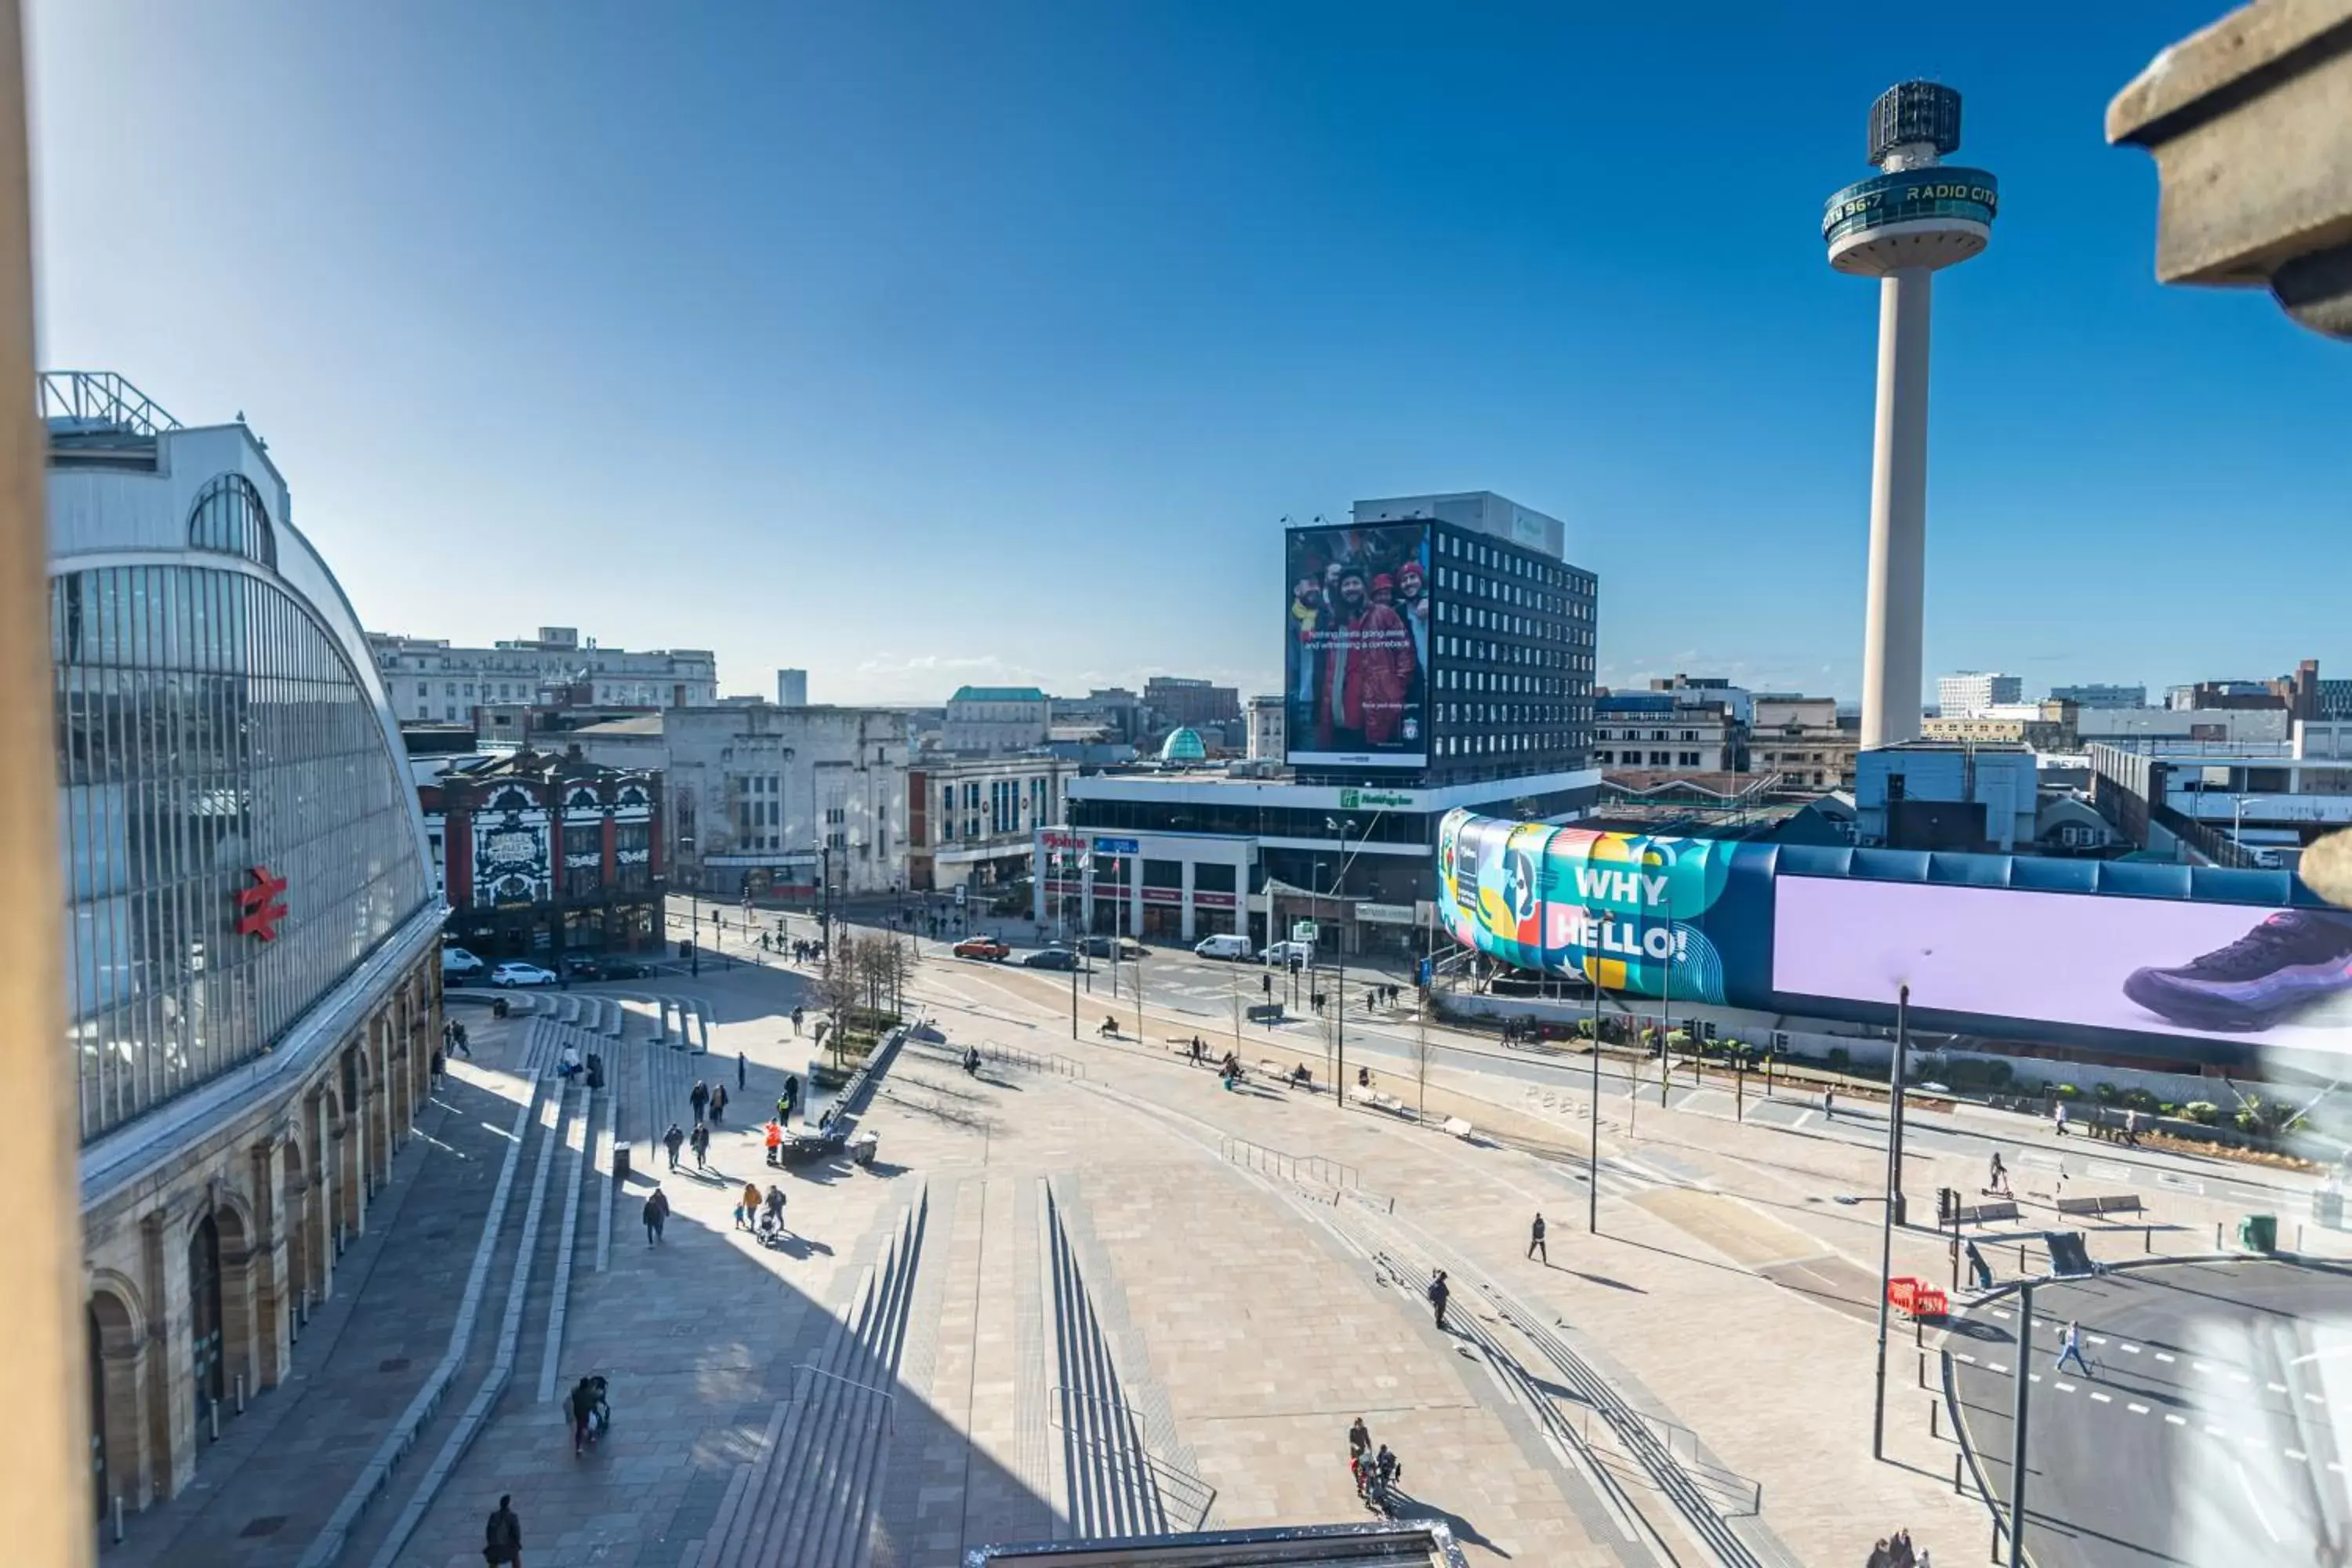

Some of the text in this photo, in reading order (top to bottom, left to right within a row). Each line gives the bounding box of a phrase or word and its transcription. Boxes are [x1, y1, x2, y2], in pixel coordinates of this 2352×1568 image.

[1906, 184, 1968, 201] RADIO
[1361, 630, 1384, 640] going
[1305, 641, 1319, 650] and
[1320, 641, 1361, 651] witnessing
[1368, 640, 1410, 649] comeback
[1361, 793, 1397, 808] Holiday
[1574, 866, 1669, 906] WHY
[1556, 912, 1688, 963] HELLO!
